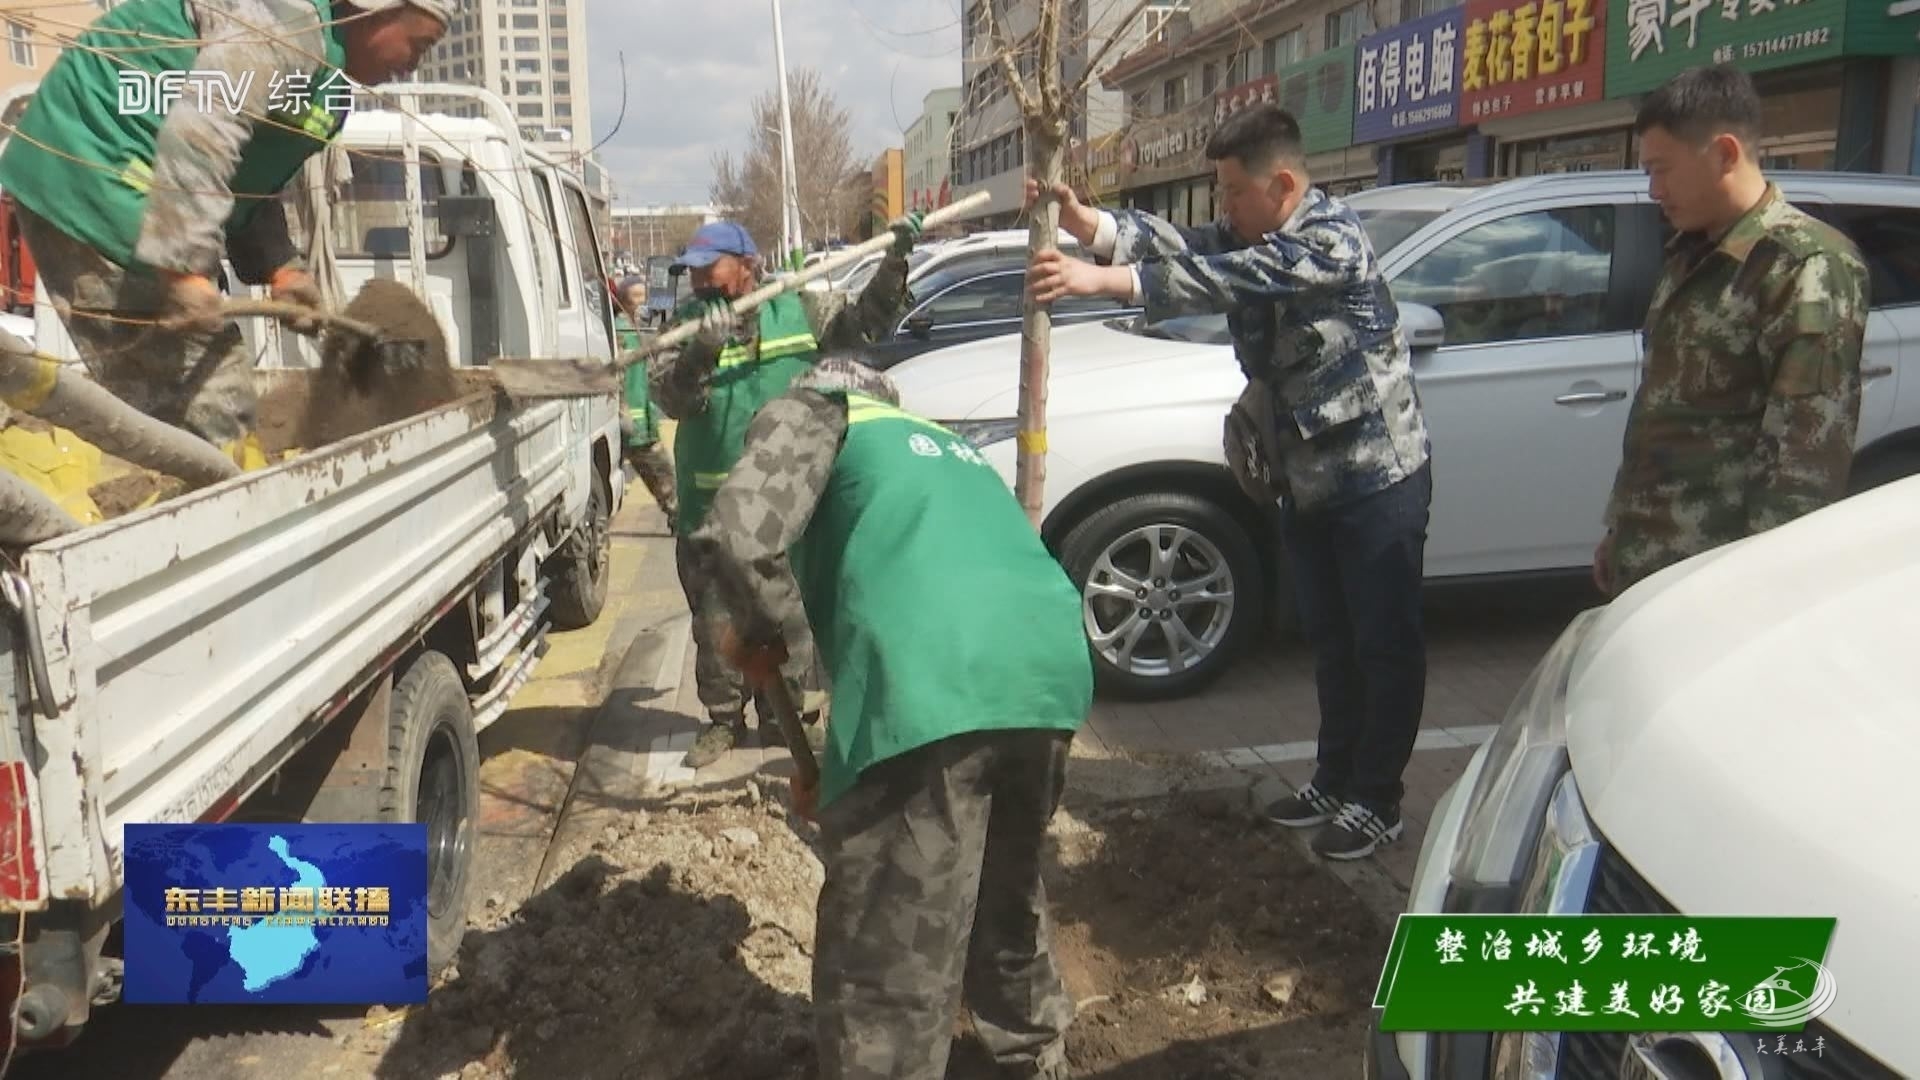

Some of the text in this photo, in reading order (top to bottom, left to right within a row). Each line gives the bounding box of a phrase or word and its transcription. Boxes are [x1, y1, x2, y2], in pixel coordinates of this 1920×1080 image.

[1358, 22, 1457, 114] 佰得电脑
[1463, 0, 1595, 91] 麦花香包子
